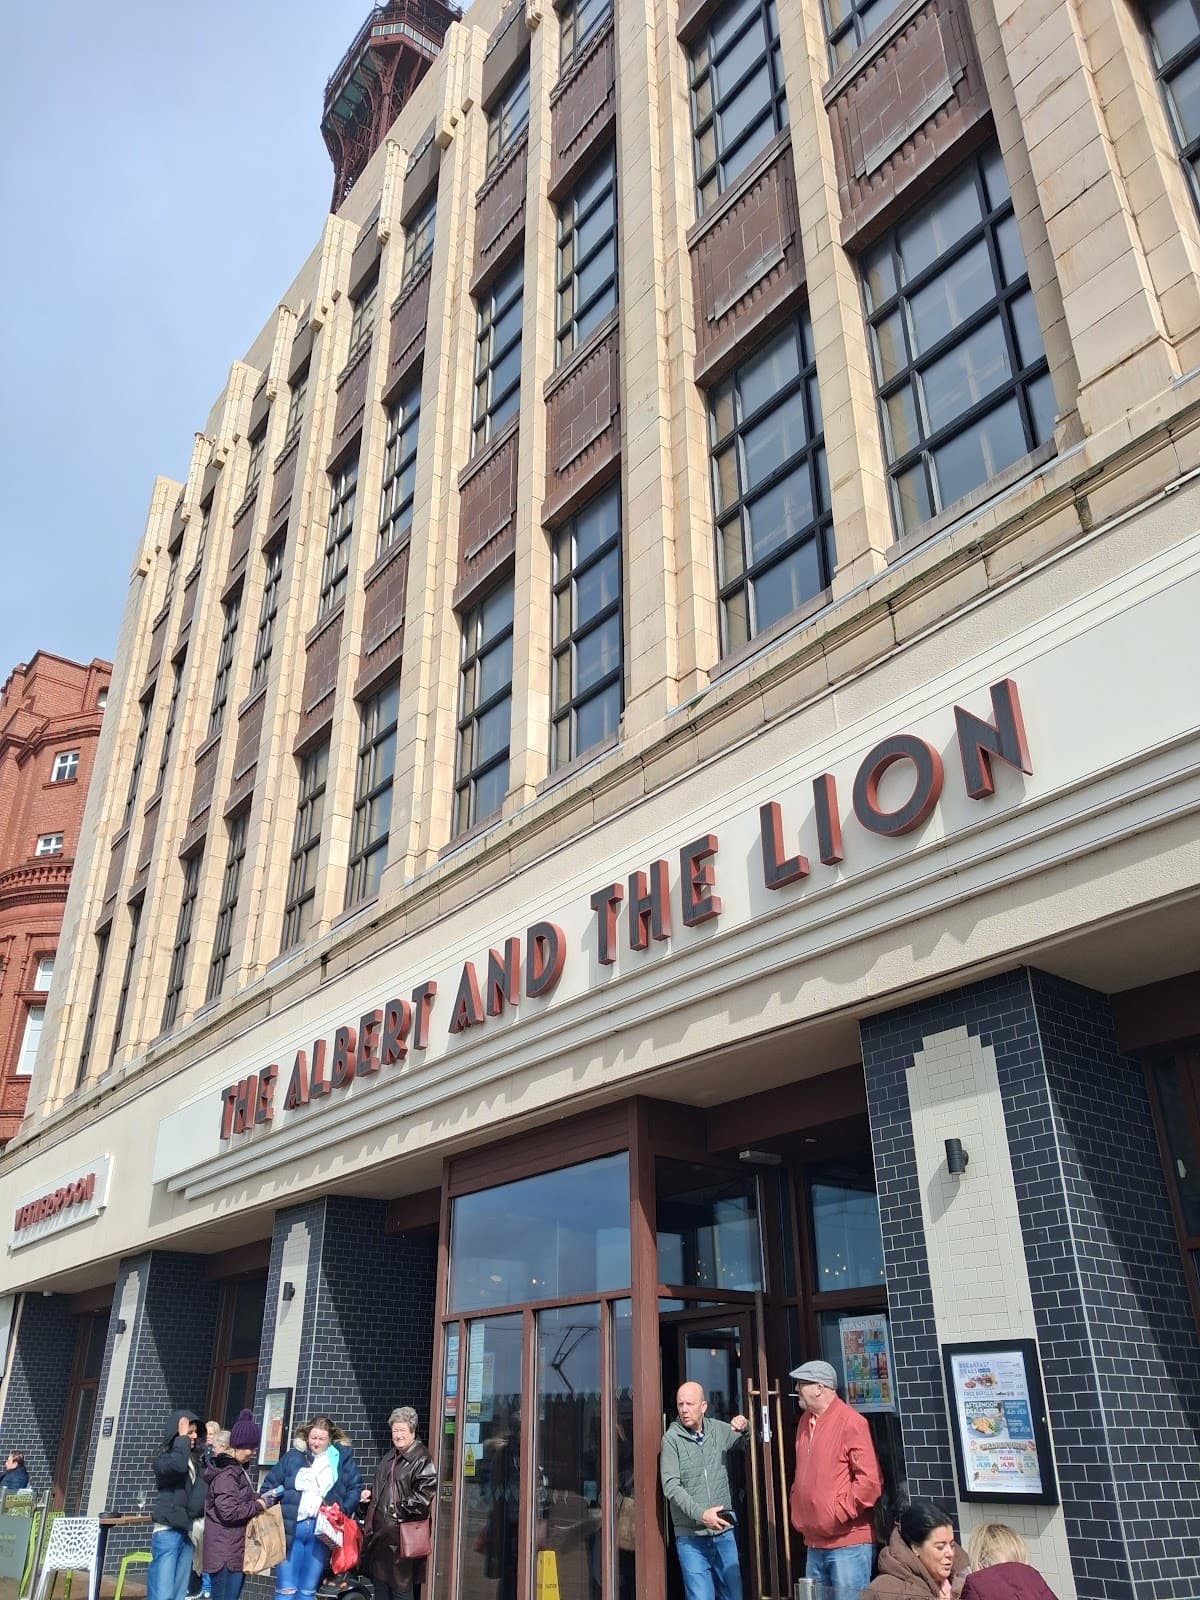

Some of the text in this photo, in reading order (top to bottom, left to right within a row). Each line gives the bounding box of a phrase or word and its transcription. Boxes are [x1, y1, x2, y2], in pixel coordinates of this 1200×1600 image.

[220, 678, 1033, 1140] THE ALBERT AND THE LION
